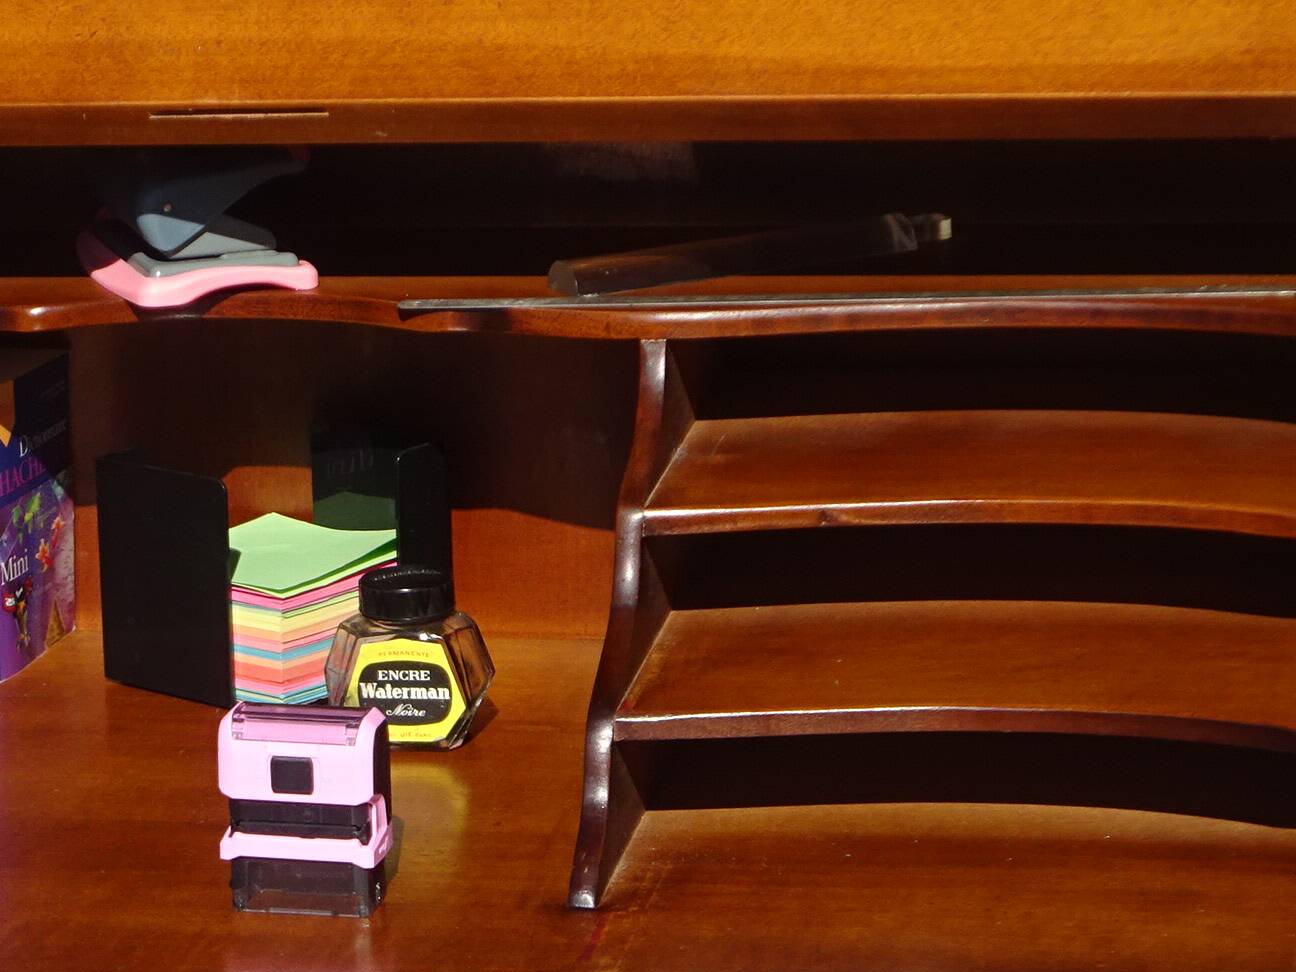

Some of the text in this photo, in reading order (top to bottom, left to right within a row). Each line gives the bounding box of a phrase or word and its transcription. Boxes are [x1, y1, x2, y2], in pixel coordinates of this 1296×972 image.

[2, 549, 29, 585] Mini
[377, 669, 430, 681] ENCRE
[359, 682, 450, 700] Waterman
[385, 703, 426, 716] Noire
